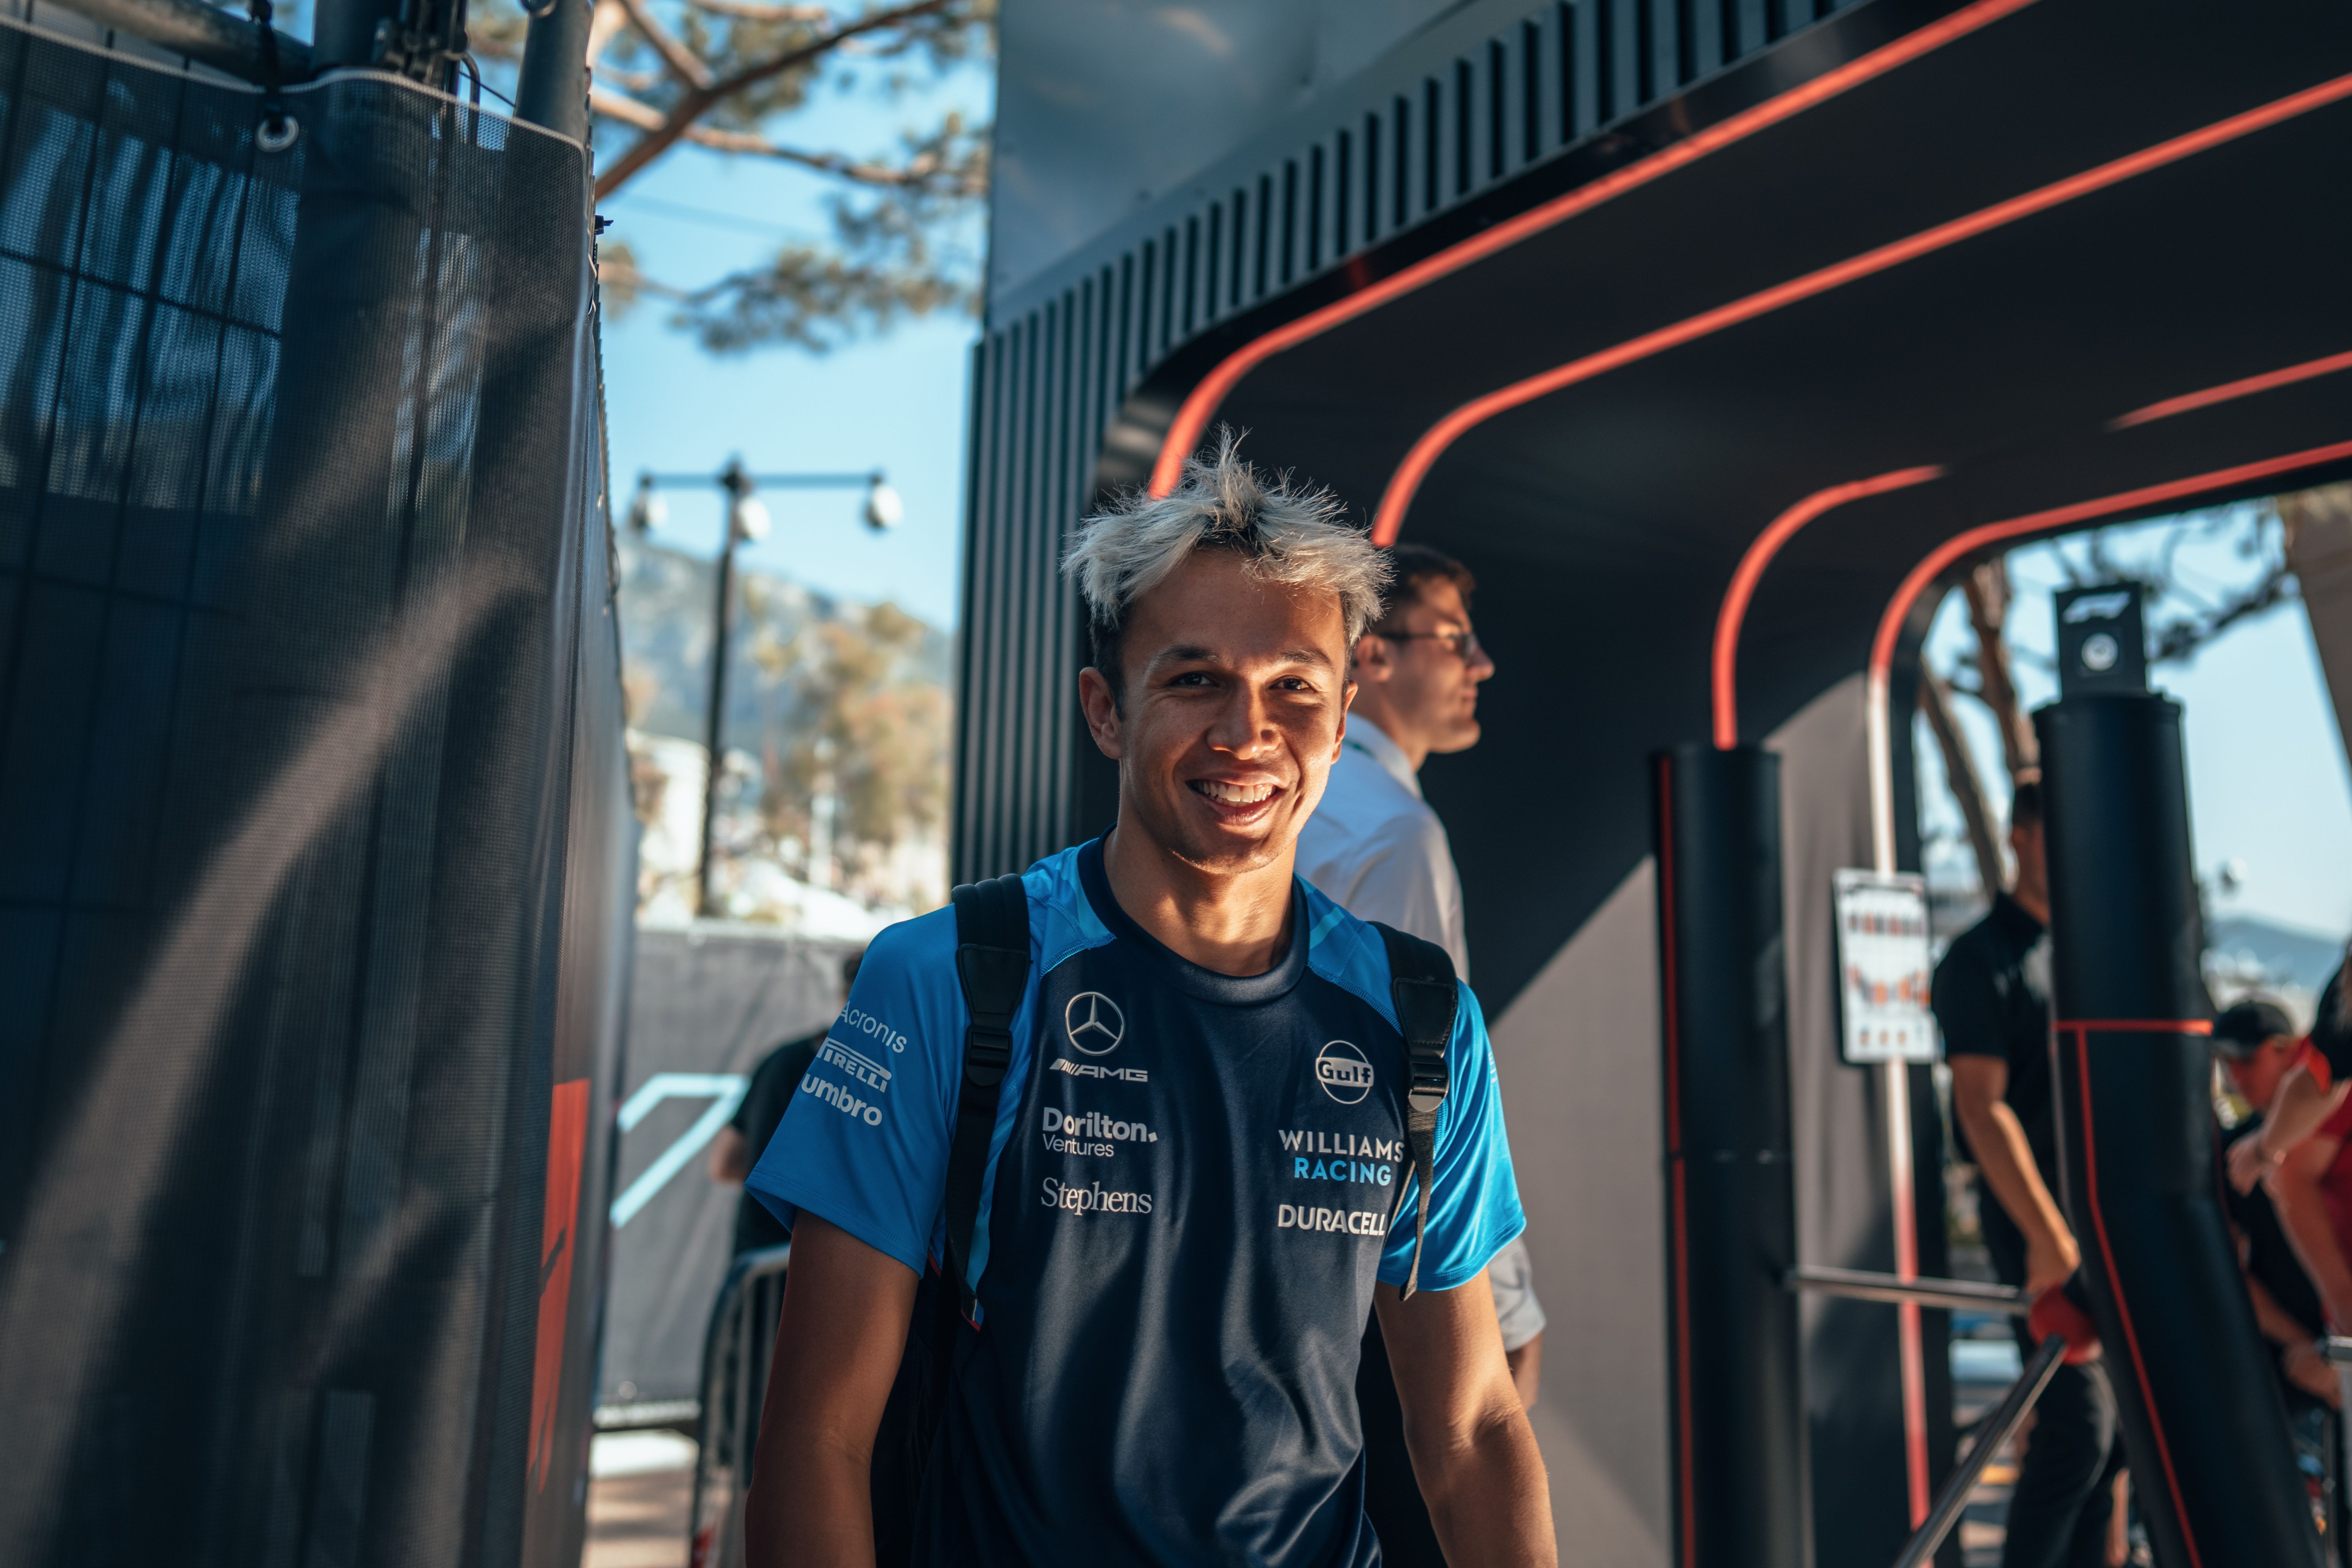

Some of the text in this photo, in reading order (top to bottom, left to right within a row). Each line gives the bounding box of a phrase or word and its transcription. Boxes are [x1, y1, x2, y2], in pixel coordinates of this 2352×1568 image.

[840, 1000, 907, 1053] Acronis
[816, 1037, 892, 1093] PIRELLI
[1074, 1065, 1148, 1082] AMG
[1318, 1060, 1371, 1084] Gulf
[801, 1073, 882, 1126] umbro
[1042, 1133, 1114, 1157] Ventures
[1278, 1130, 1405, 1163] WILLIAMS
[1294, 1157, 1392, 1186] RACING
[1041, 1177, 1152, 1216] Stephens
[1277, 1204, 1386, 1236] DURACELL
